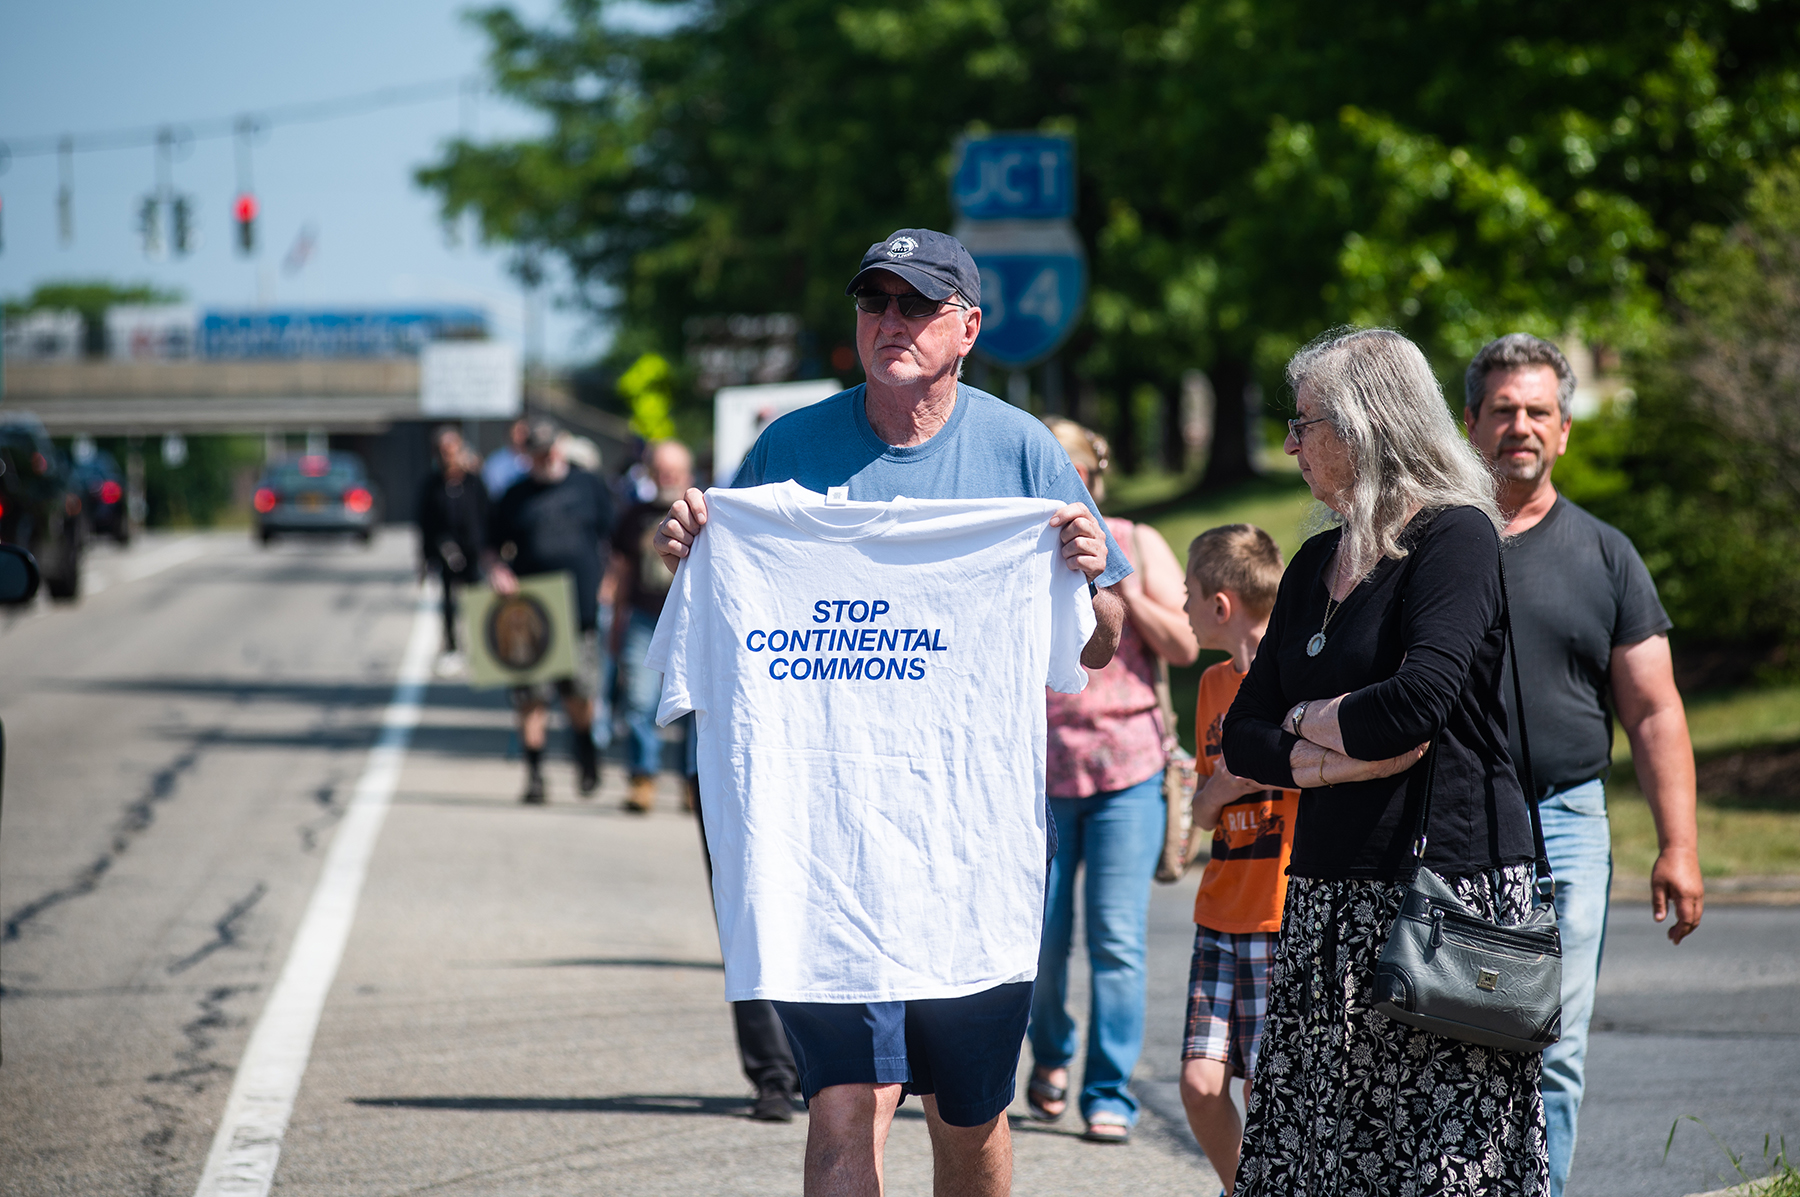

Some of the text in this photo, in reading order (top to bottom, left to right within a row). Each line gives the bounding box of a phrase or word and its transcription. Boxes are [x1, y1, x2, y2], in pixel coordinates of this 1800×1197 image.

[957, 150, 1058, 207] JCT
[812, 600, 890, 623] STOP
[746, 628, 948, 652] CONTINENTAL
[768, 657, 926, 680] COMMONS
